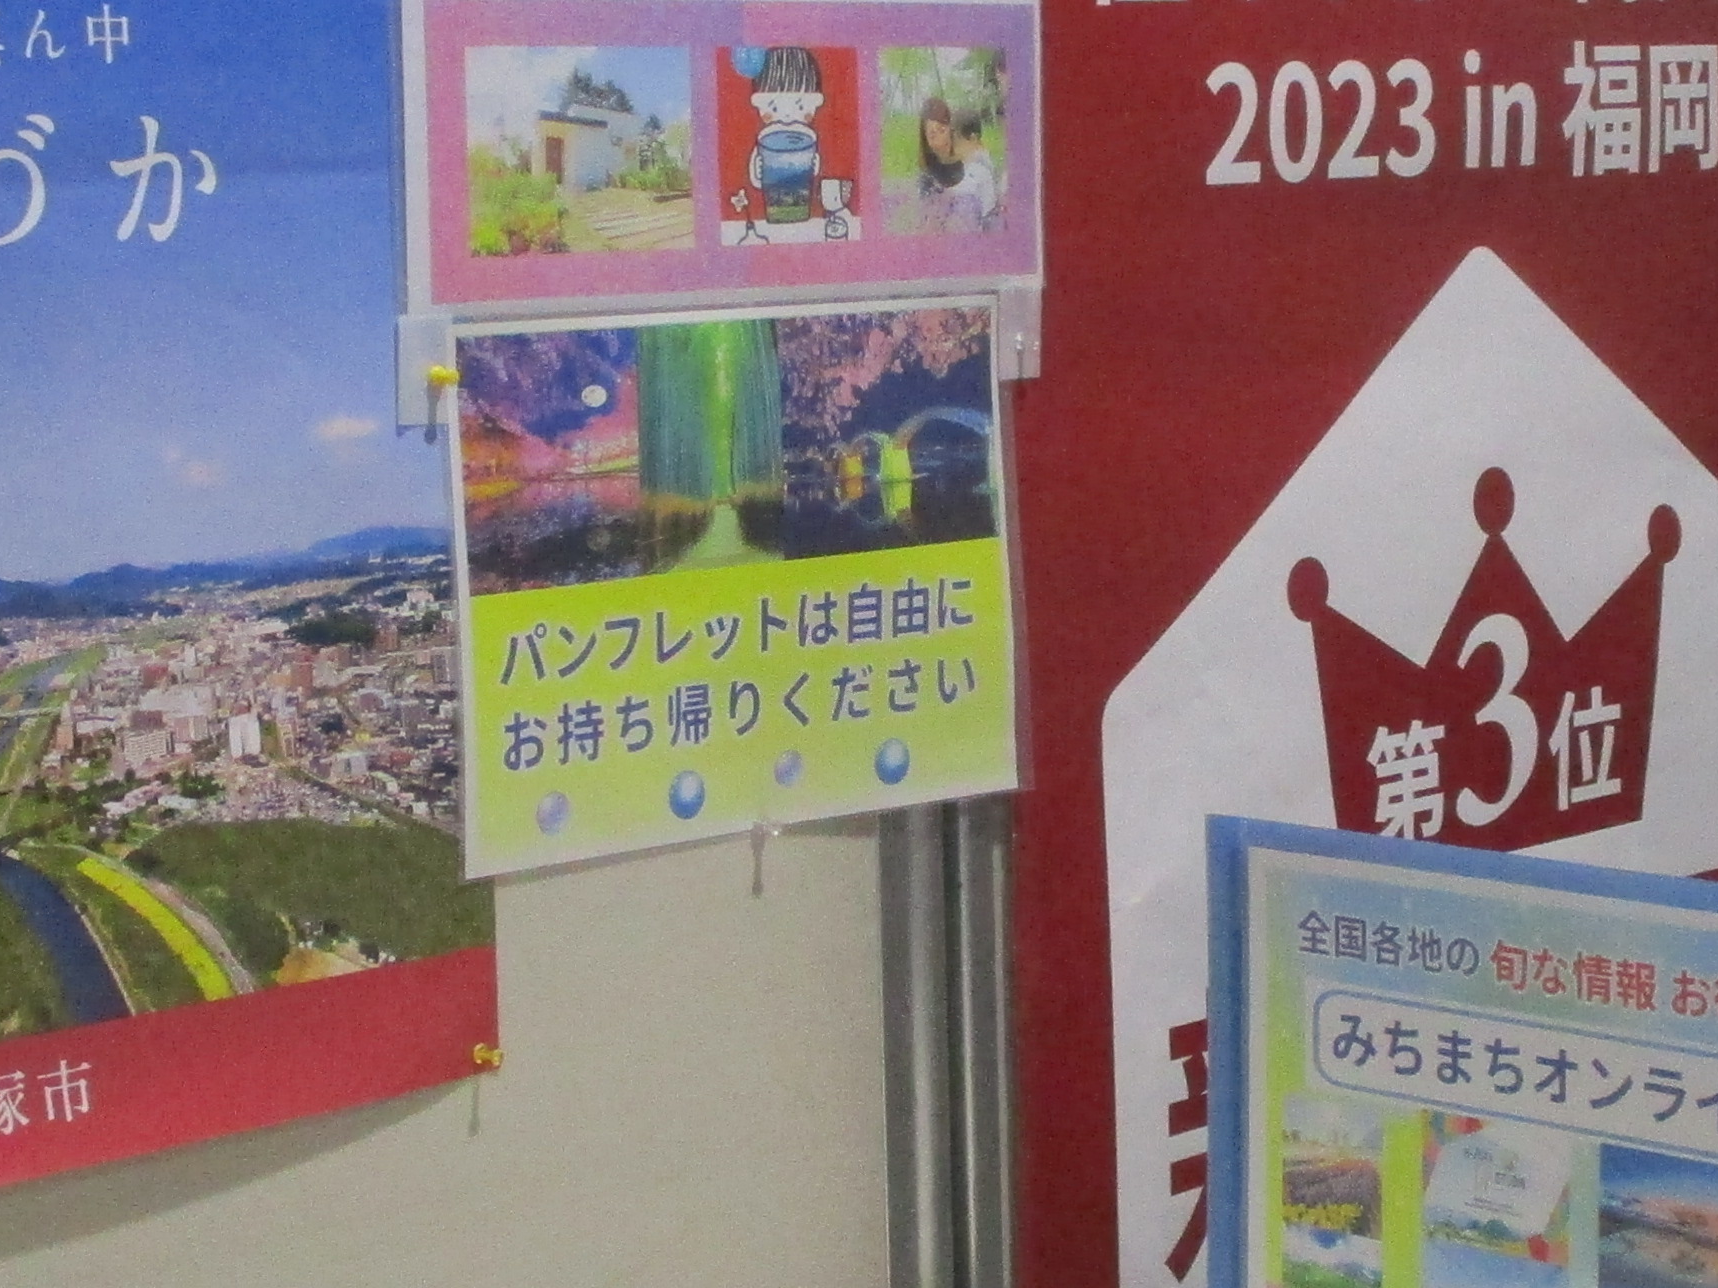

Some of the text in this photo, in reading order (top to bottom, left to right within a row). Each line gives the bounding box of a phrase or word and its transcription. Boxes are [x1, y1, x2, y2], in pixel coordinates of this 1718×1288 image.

[1205, 58, 1437, 187] 2023
[1464, 48, 1538, 169] in
[499, 576, 975, 687] パンフレットは自由に
[502, 657, 976, 772] お持ち帰りください
[1366, 612, 1622, 841] 第3位
